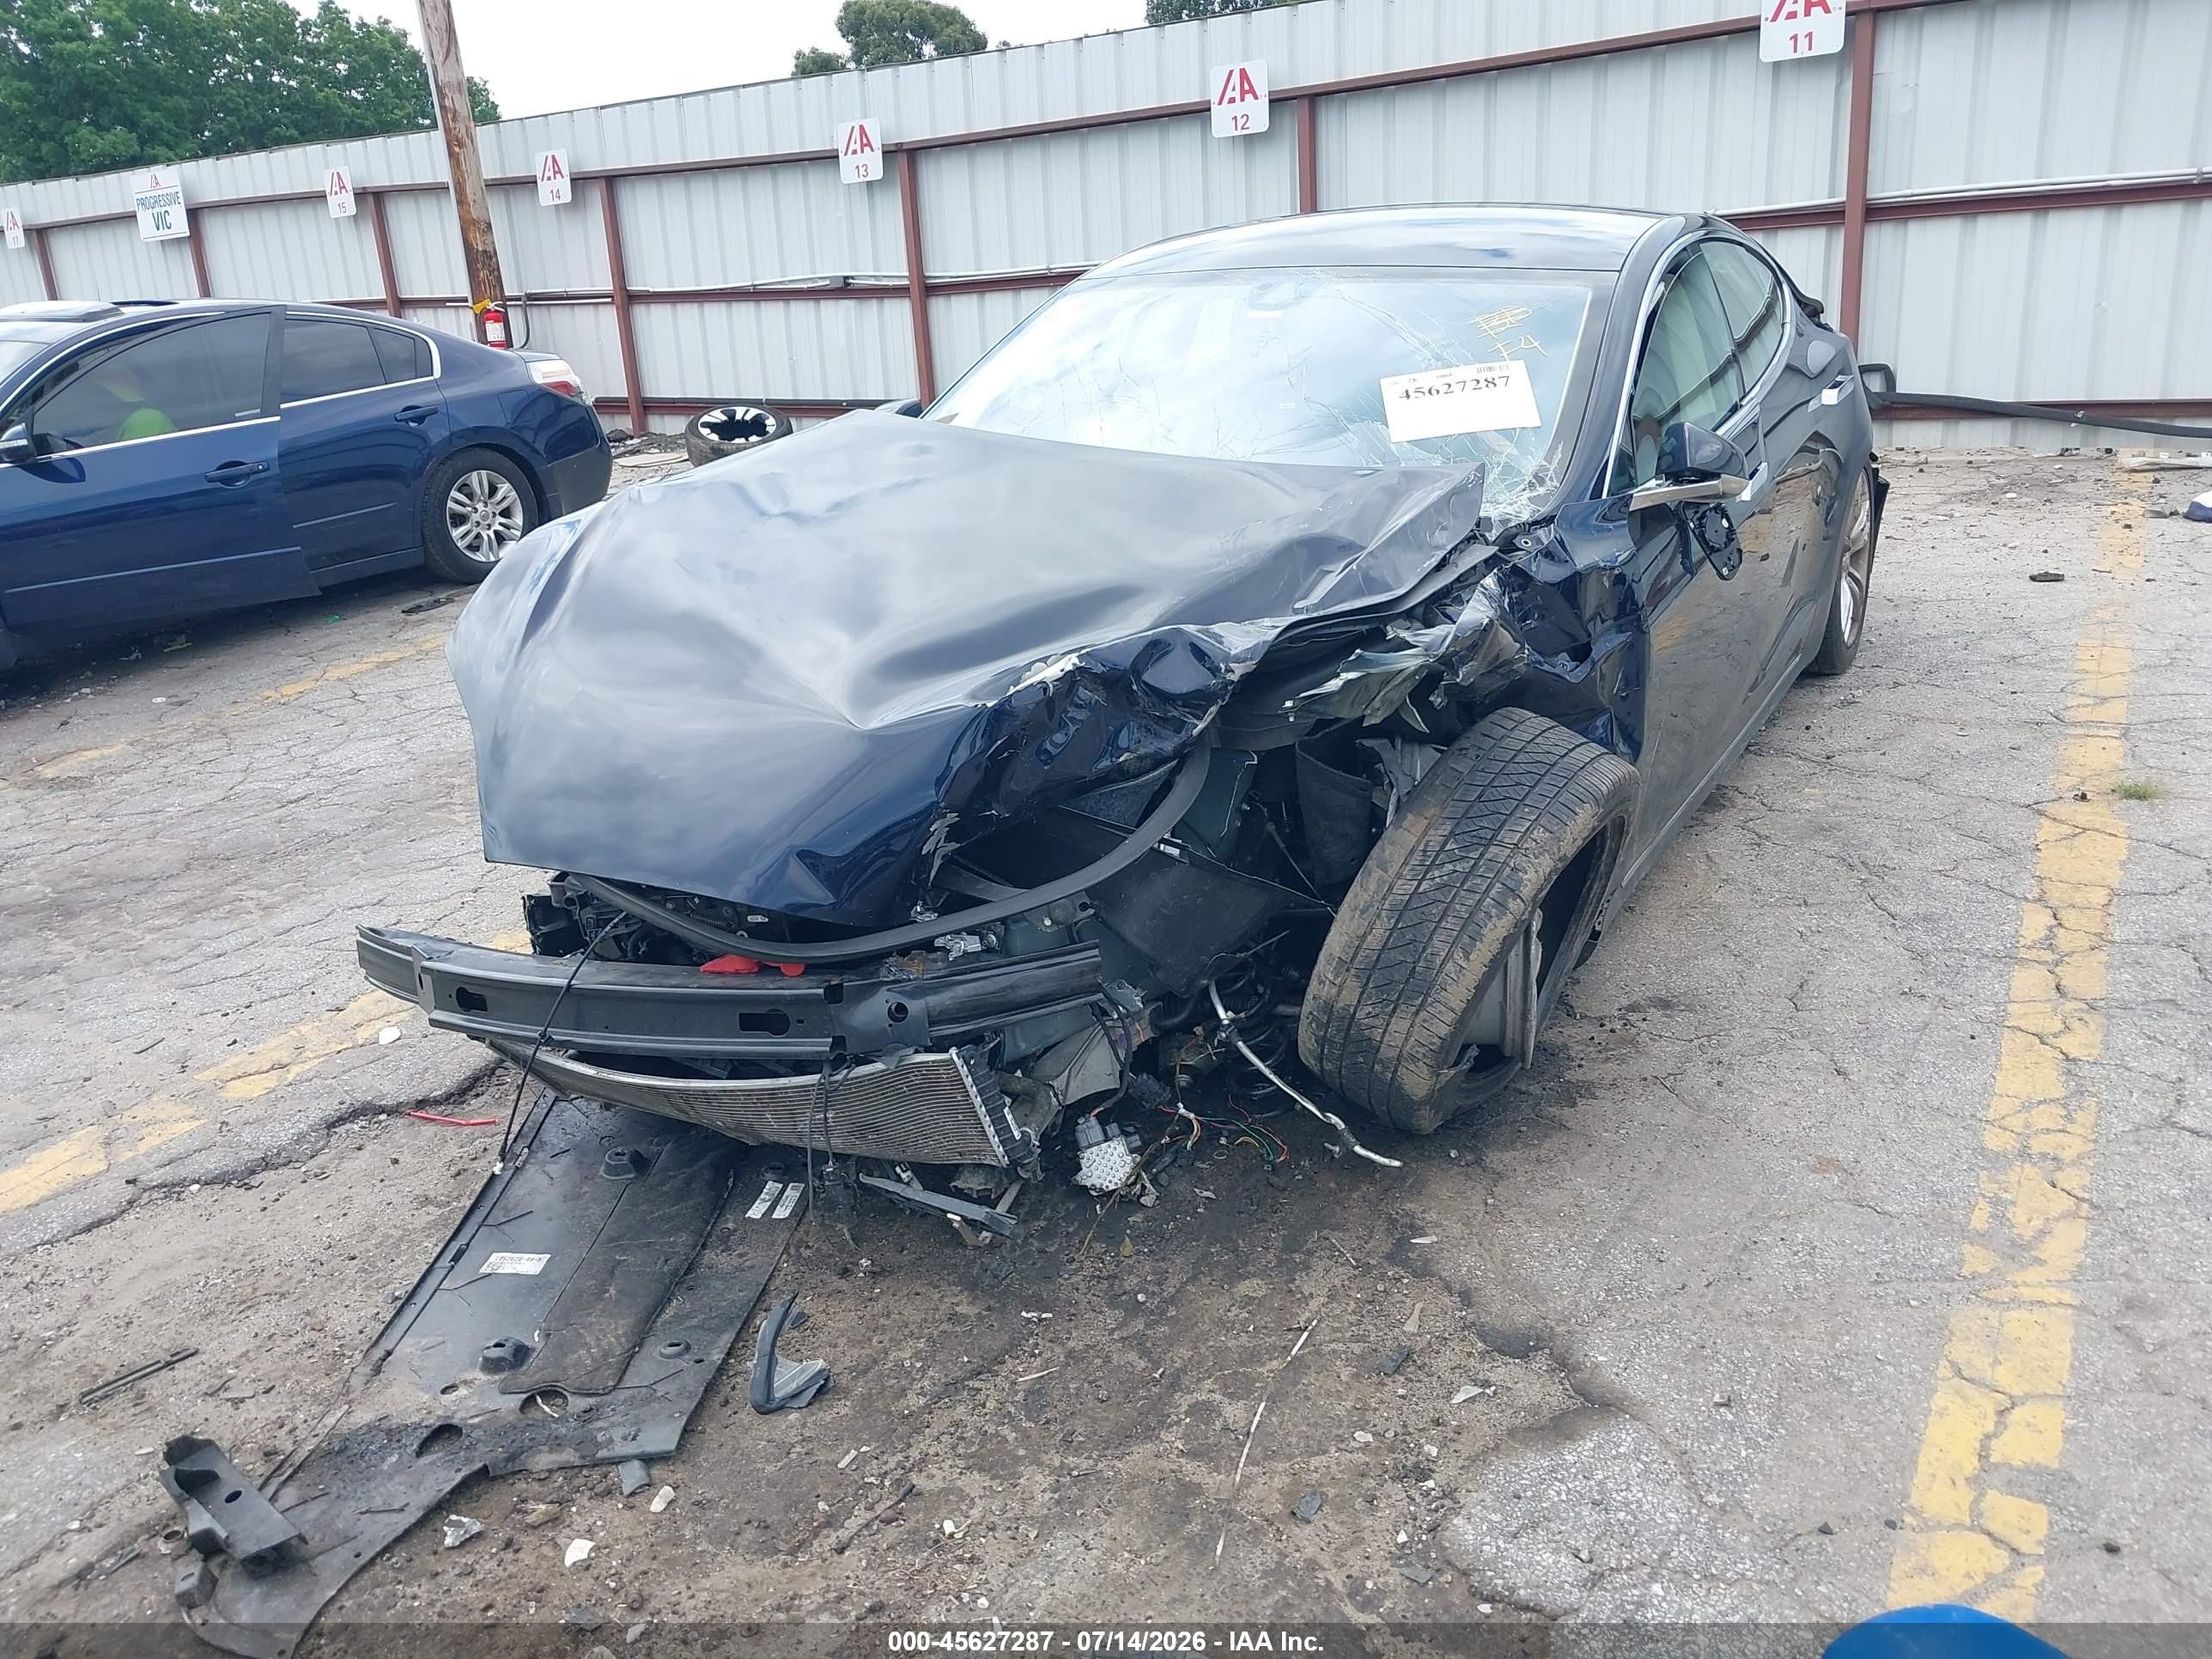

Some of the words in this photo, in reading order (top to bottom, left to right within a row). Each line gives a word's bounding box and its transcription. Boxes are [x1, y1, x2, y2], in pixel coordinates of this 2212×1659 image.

[1789, 31, 1814, 53] 11
[1231, 112, 1250, 131] 12
[854, 163, 870, 179] 13
[136, 191, 182, 212] PROGRESSIVE
[550, 187, 562, 202] 14
[337, 201, 347, 214] 15
[151, 210, 172, 231] VIC
[1398, 374, 1510, 400] 45627287
